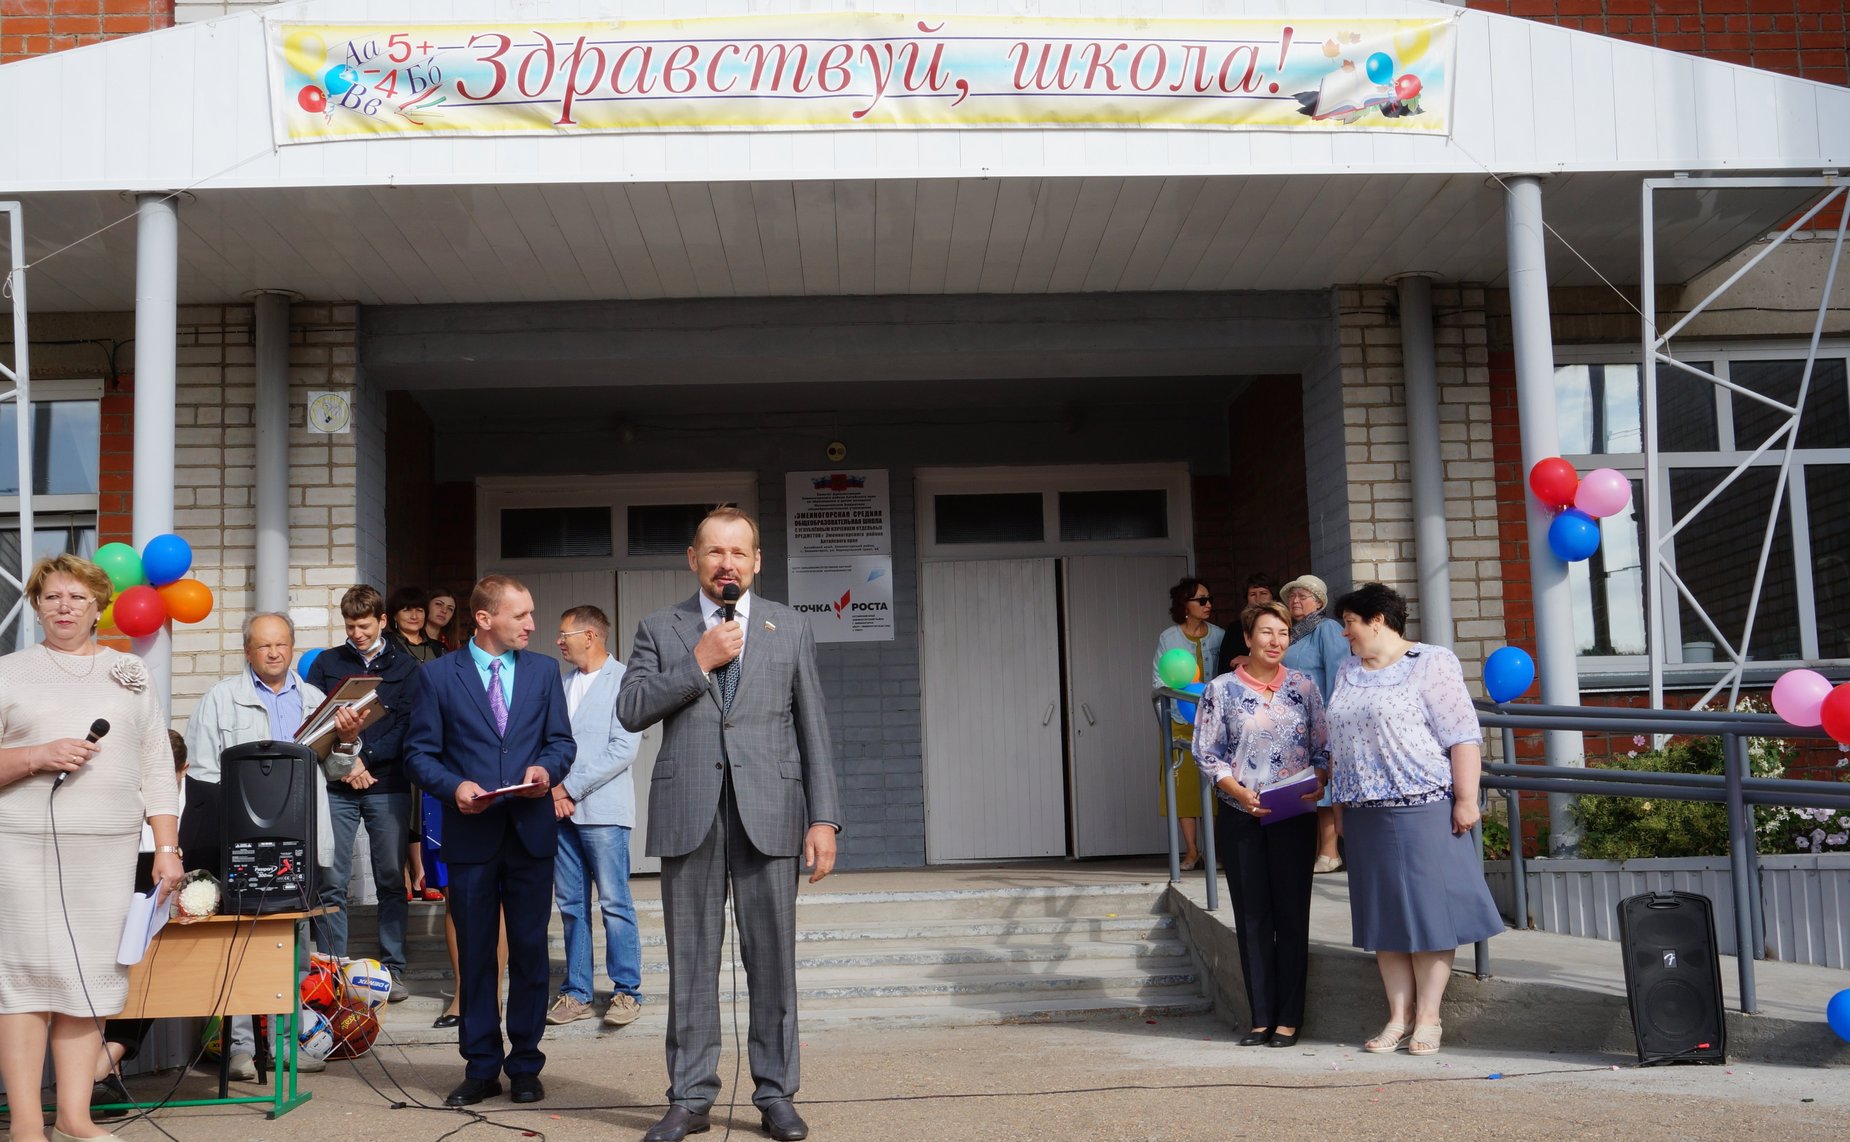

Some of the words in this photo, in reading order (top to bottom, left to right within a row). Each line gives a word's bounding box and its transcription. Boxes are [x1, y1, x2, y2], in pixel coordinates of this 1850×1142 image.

[406, 57, 442, 95] Бб
[457, 21, 969, 125] Здравствуй,
[1007, 27, 1294, 95] школа!
[853, 510, 882, 518] СРЕДНЯЯ
[793, 603, 832, 613] ТОЧКА
[851, 602, 888, 611] РОСТА
